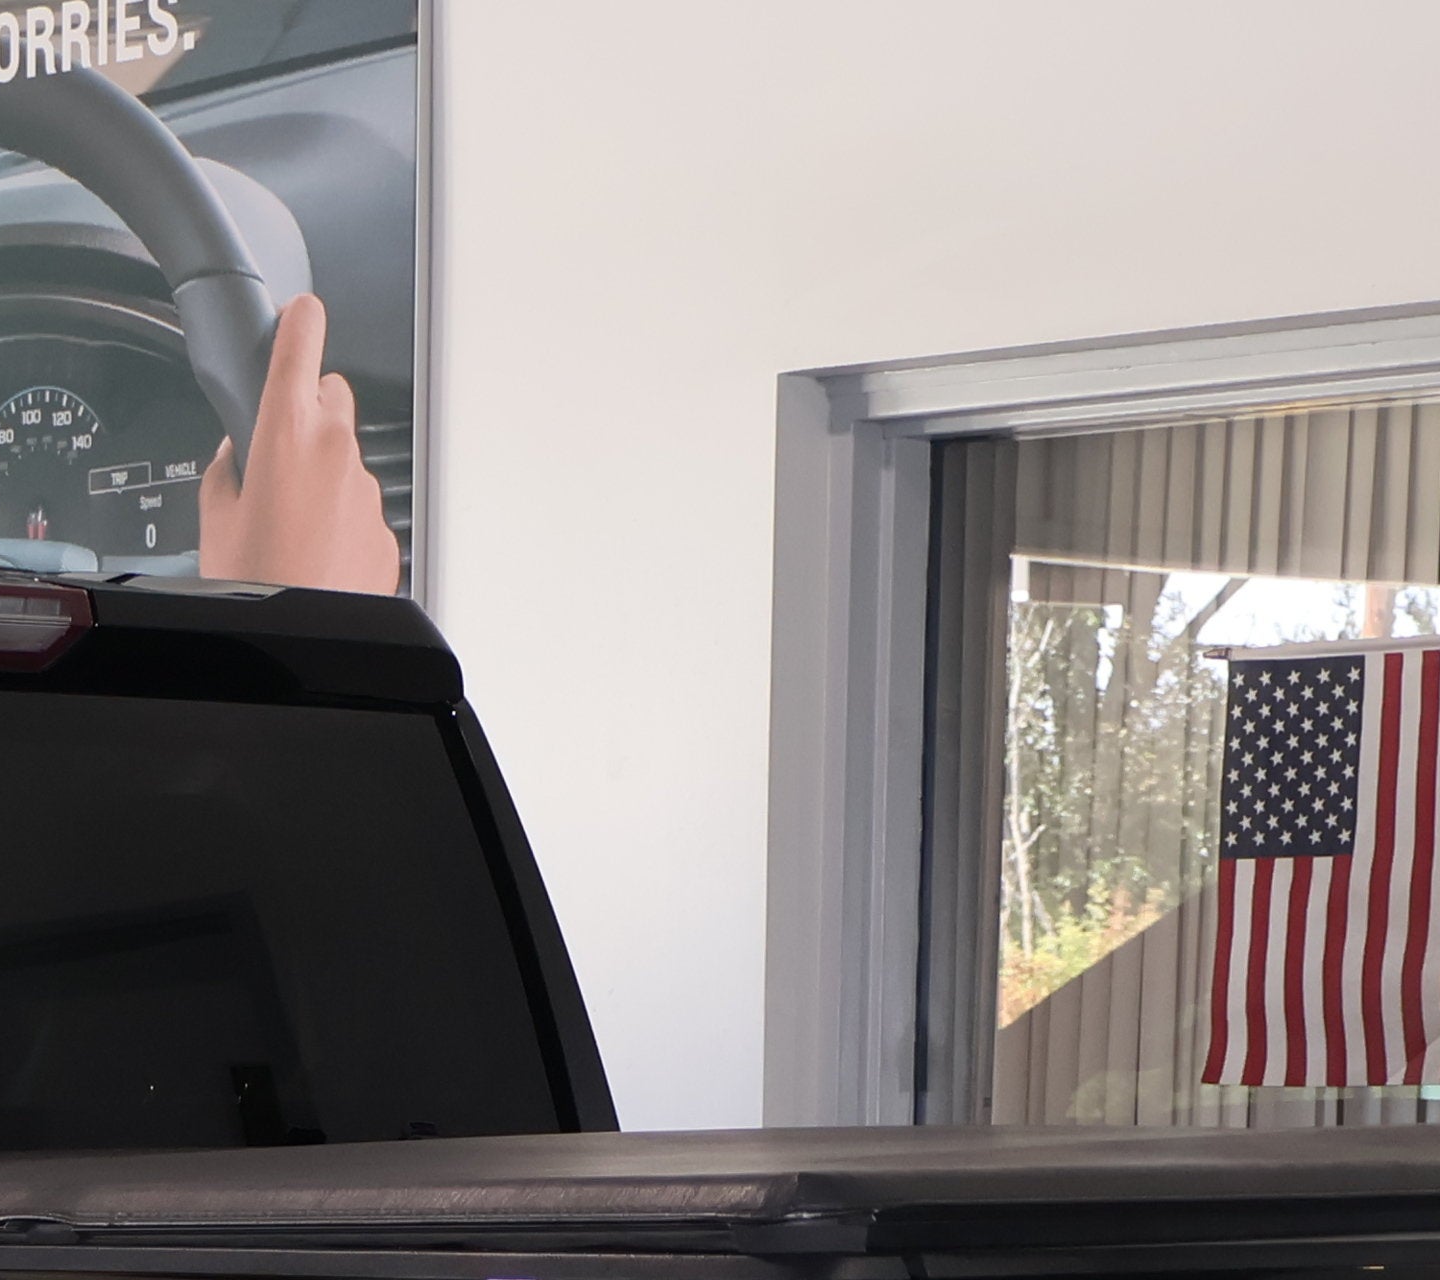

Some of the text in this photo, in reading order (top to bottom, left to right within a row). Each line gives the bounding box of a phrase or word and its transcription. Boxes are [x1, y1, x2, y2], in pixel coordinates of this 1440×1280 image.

[22, 409, 41, 425] 100
[52, 410, 72, 426] 120
[72, 434, 92, 450] 140
[165, 461, 196, 478] VEHICLE
[145, 523, 156, 549] 0
